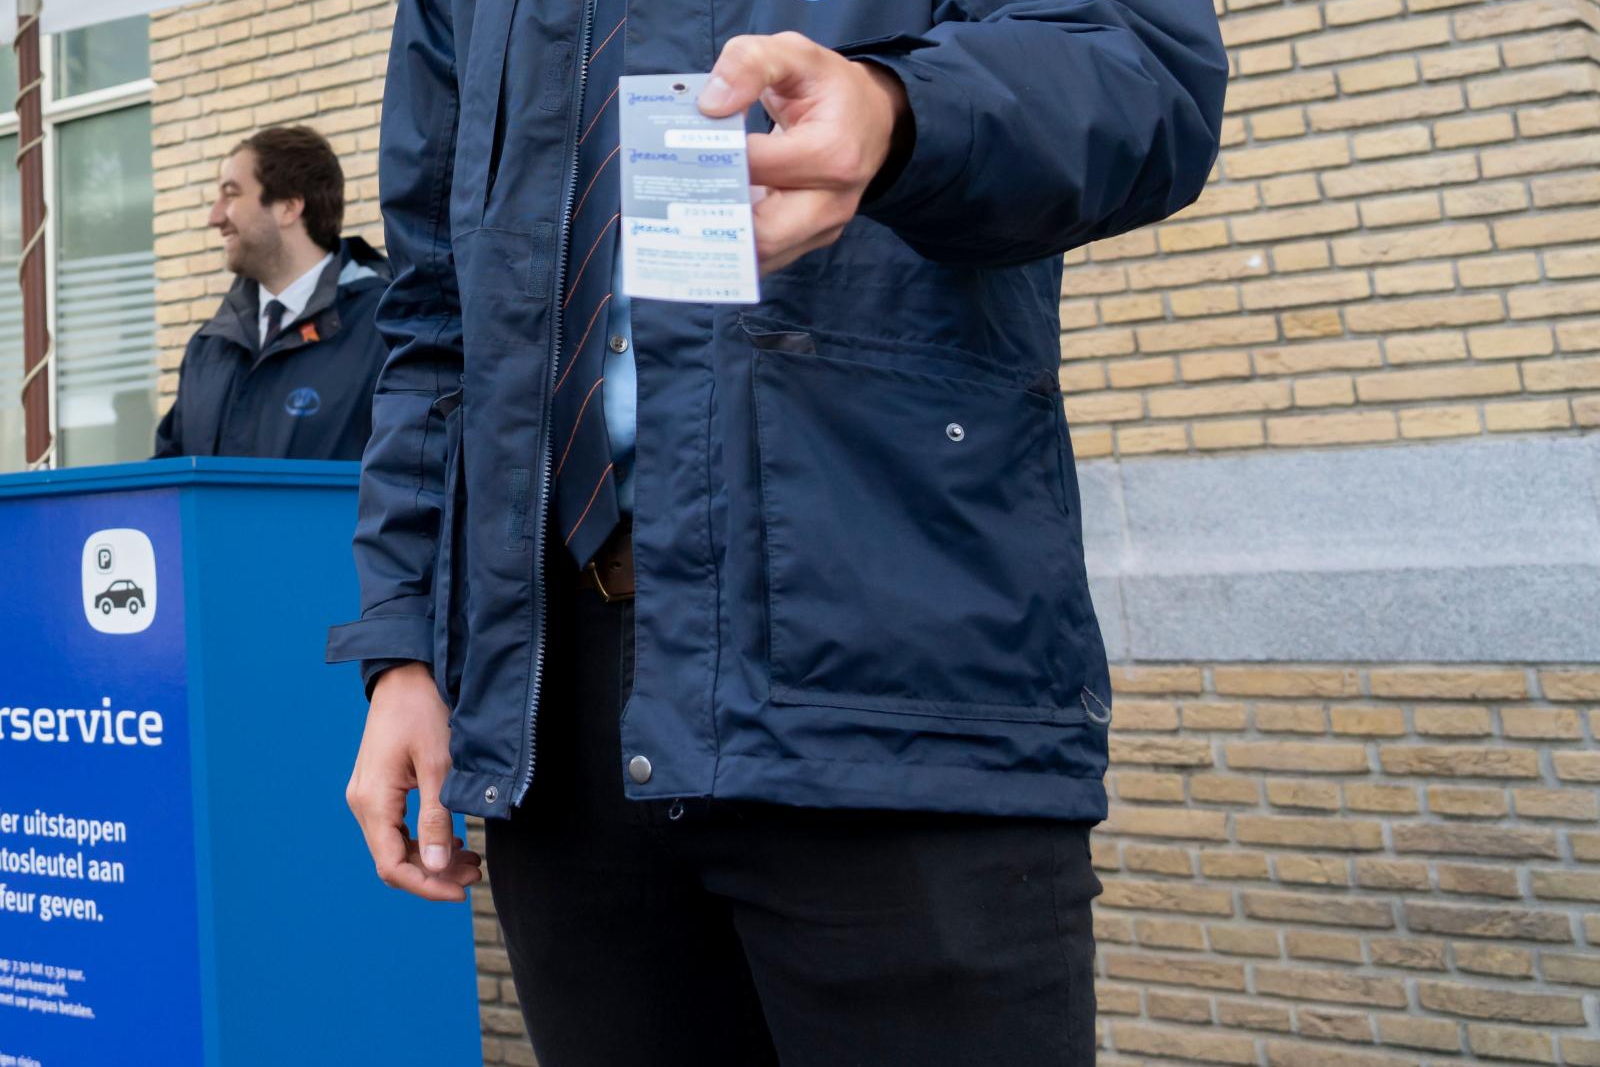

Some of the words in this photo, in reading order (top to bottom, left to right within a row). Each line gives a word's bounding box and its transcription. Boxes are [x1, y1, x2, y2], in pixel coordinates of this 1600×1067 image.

[24, 809, 127, 846] uitstappen
[88, 860, 124, 883] aan
[40, 894, 104, 922] geven.
[31, 962, 43, 975] tot
[15, 978, 68, 997] parkeergeld.
[15, 995, 28, 1008] uw
[28, 996, 58, 1014] pinpas
[59, 1000, 95, 1019] betalen.
